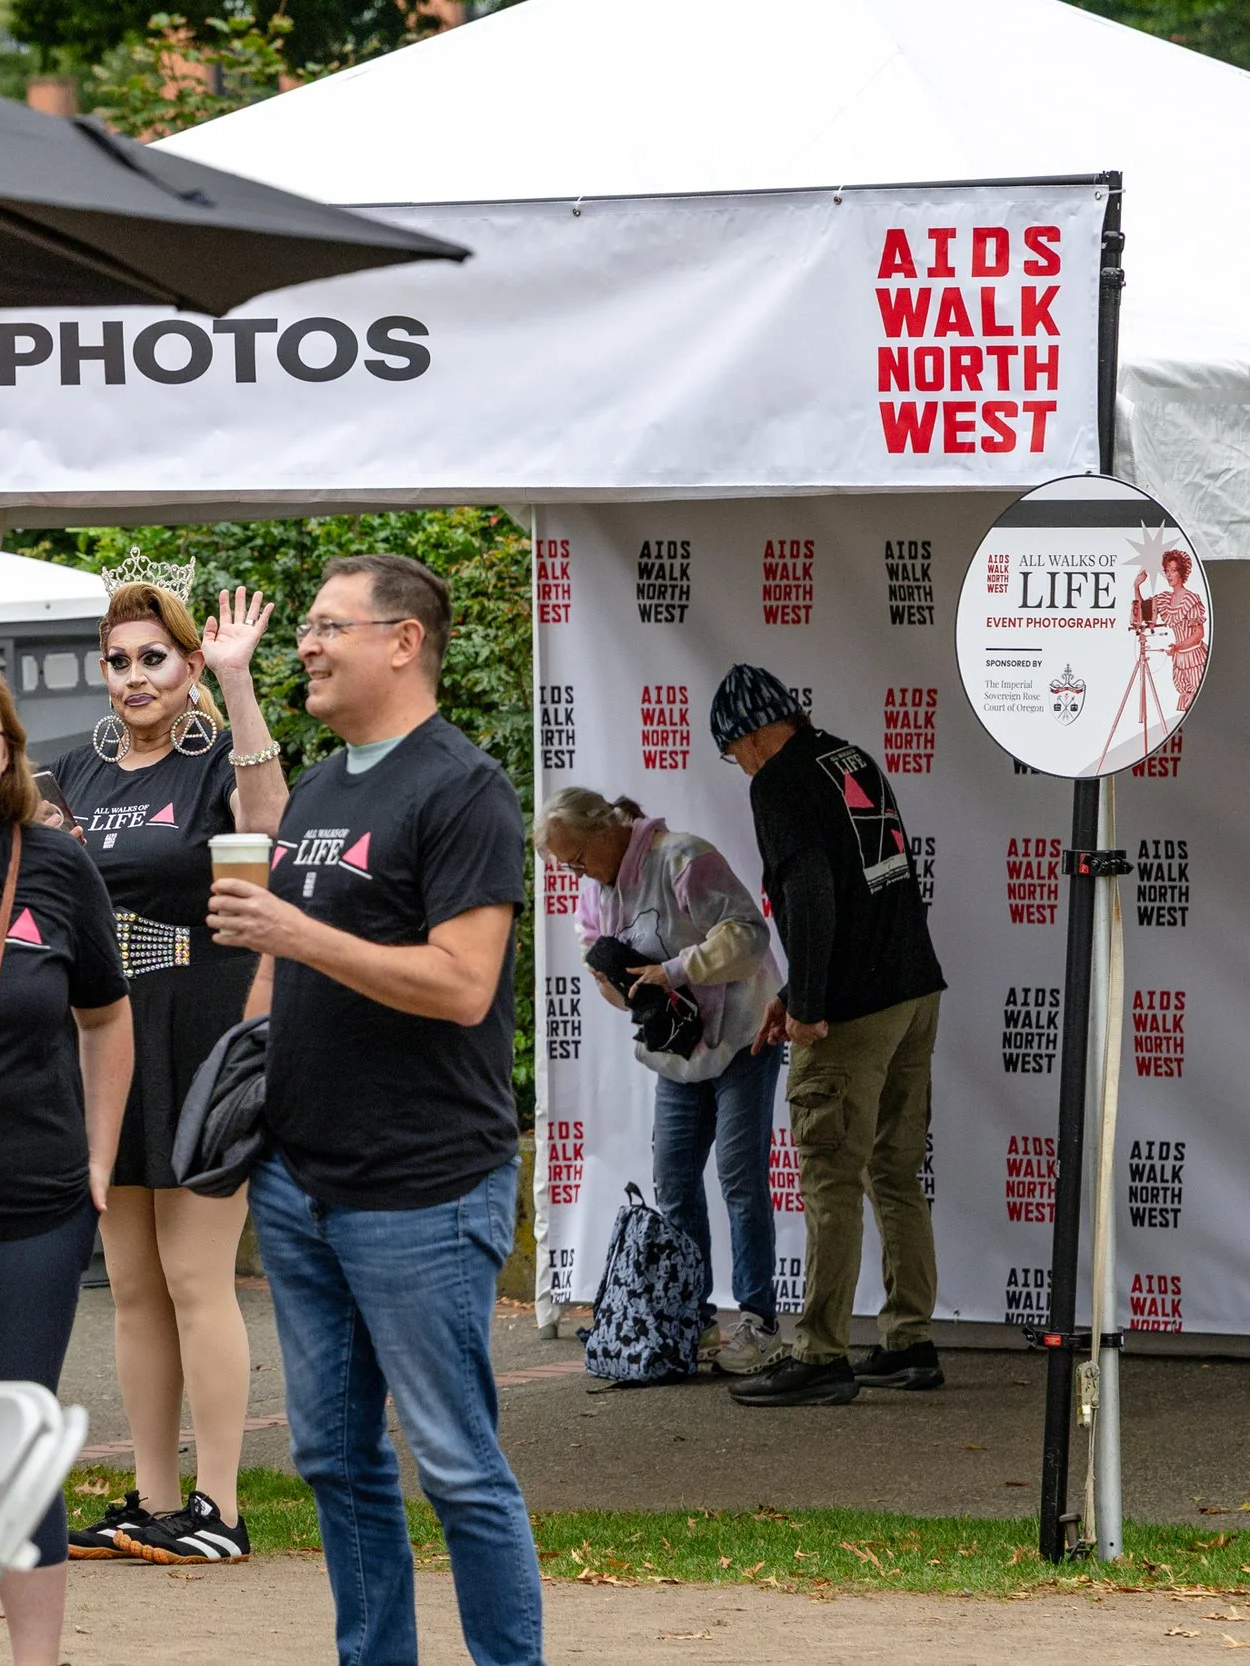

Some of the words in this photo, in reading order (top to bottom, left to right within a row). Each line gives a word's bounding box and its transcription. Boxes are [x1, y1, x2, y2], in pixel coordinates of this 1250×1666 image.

[877, 225, 1061, 279] AIDS
[875, 285, 1061, 338] WALK
[878, 344, 1059, 392] NORTH
[878, 400, 1057, 454] WEST
[536, 539, 570, 559] IDS
[639, 540, 691, 560] AIDS
[763, 540, 815, 560] AIDS
[885, 540, 932, 560] AIDS
[988, 554, 1009, 563] AIDS
[987, 565, 1009, 574] WALK
[1019, 555, 1046, 567] ALL
[1049, 555, 1096, 567] WALKS
[1099, 554, 1117, 567] OF
[537, 562, 570, 580] ALK
[637, 562, 691, 582] WALK
[763, 562, 813, 581] WALK
[885, 562, 932, 583] WALK
[537, 583, 571, 600] RTH
[636, 584, 691, 602] NORTH
[762, 585, 813, 602] NORTH
[889, 585, 933, 603] NORTH
[987, 584, 1009, 593] WEST
[1018, 571, 1116, 609] LIFE
[540, 603, 571, 623] EST
[638, 604, 688, 623] WEST
[763, 604, 813, 625] WEST
[890, 605, 935, 625] WEST
[986, 617, 1024, 628] EVENT
[1026, 617, 1116, 629] PHOTOGRAPHY
[985, 680, 1000, 689] The
[1001, 680, 1033, 690] Imperial
[539, 686, 574, 705] IDS
[641, 686, 689, 705] AIDS
[789, 688, 812, 706] DS
[884, 688, 938, 707] AIDS
[984, 692, 1022, 702] Sovereign
[1023, 692, 1041, 700] Rose
[541, 707, 574, 726] ALK
[641, 708, 690, 727] WALK
[983, 703, 1008, 711] Court
[1009, 703, 1016, 711] of
[1016, 703, 1045, 713] Oregon
[884, 711, 936, 730] WALK
[540, 729, 575, 746] RTH
[642, 730, 690, 747] NORTH
[884, 733, 935, 750] NORTH
[544, 749, 575, 769] EST
[643, 751, 690, 769] WEST
[884, 754, 934, 773] WEST
[94, 807, 110, 815] ALL
[111, 805, 138, 814] WALKS
[88, 811, 147, 831] LIFE
[293, 839, 345, 866] LIFE
[911, 837, 936, 856] DS
[1007, 838, 1061, 859] AIDS
[1138, 839, 1189, 860] AIDS
[1006, 861, 1059, 881] WALK
[1137, 862, 1189, 883] WALK
[544, 875, 579, 892] RTH
[1007, 883, 1059, 901] NORTH
[1137, 885, 1189, 903] NORTH
[547, 895, 579, 915] EST
[1008, 903, 1058, 924] WEST
[1137, 905, 1189, 927] WEST
[545, 976, 581, 996] IDS
[1005, 987, 1060, 1008] AIDS
[1133, 990, 1186, 1011] AIDS
[546, 998, 581, 1017] ALK
[546, 1020, 581, 1037] RTH
[1004, 1010, 1059, 1030] WALK
[1133, 1013, 1184, 1033] WALK
[549, 1040, 581, 1060] EST
[1002, 1032, 1058, 1050] NORTH
[1135, 1035, 1185, 1054] NORTH
[1003, 1053, 1056, 1073] WEST
[1135, 1056, 1184, 1078] WEST
[548, 1121, 583, 1140] IDS
[549, 1143, 584, 1162] ALK
[1007, 1135, 1055, 1157] AIDS
[1130, 1140, 1186, 1161] AIDS
[548, 1164, 583, 1182] RTH
[1006, 1158, 1056, 1178] WALK
[1129, 1164, 1184, 1185] WALK
[550, 1184, 581, 1205] EST
[1006, 1180, 1055, 1199] NORTH
[1129, 1186, 1182, 1204] NORTH
[771, 1192, 805, 1212] WES
[1006, 1201, 1055, 1223] WEST
[1130, 1208, 1181, 1228] WEST
[549, 1249, 575, 1268] IDS
[778, 1257, 801, 1276] ID
[550, 1270, 572, 1290] ALK
[1131, 1273, 1181, 1295] AIDS
[1130, 1296, 1182, 1318] WALK
